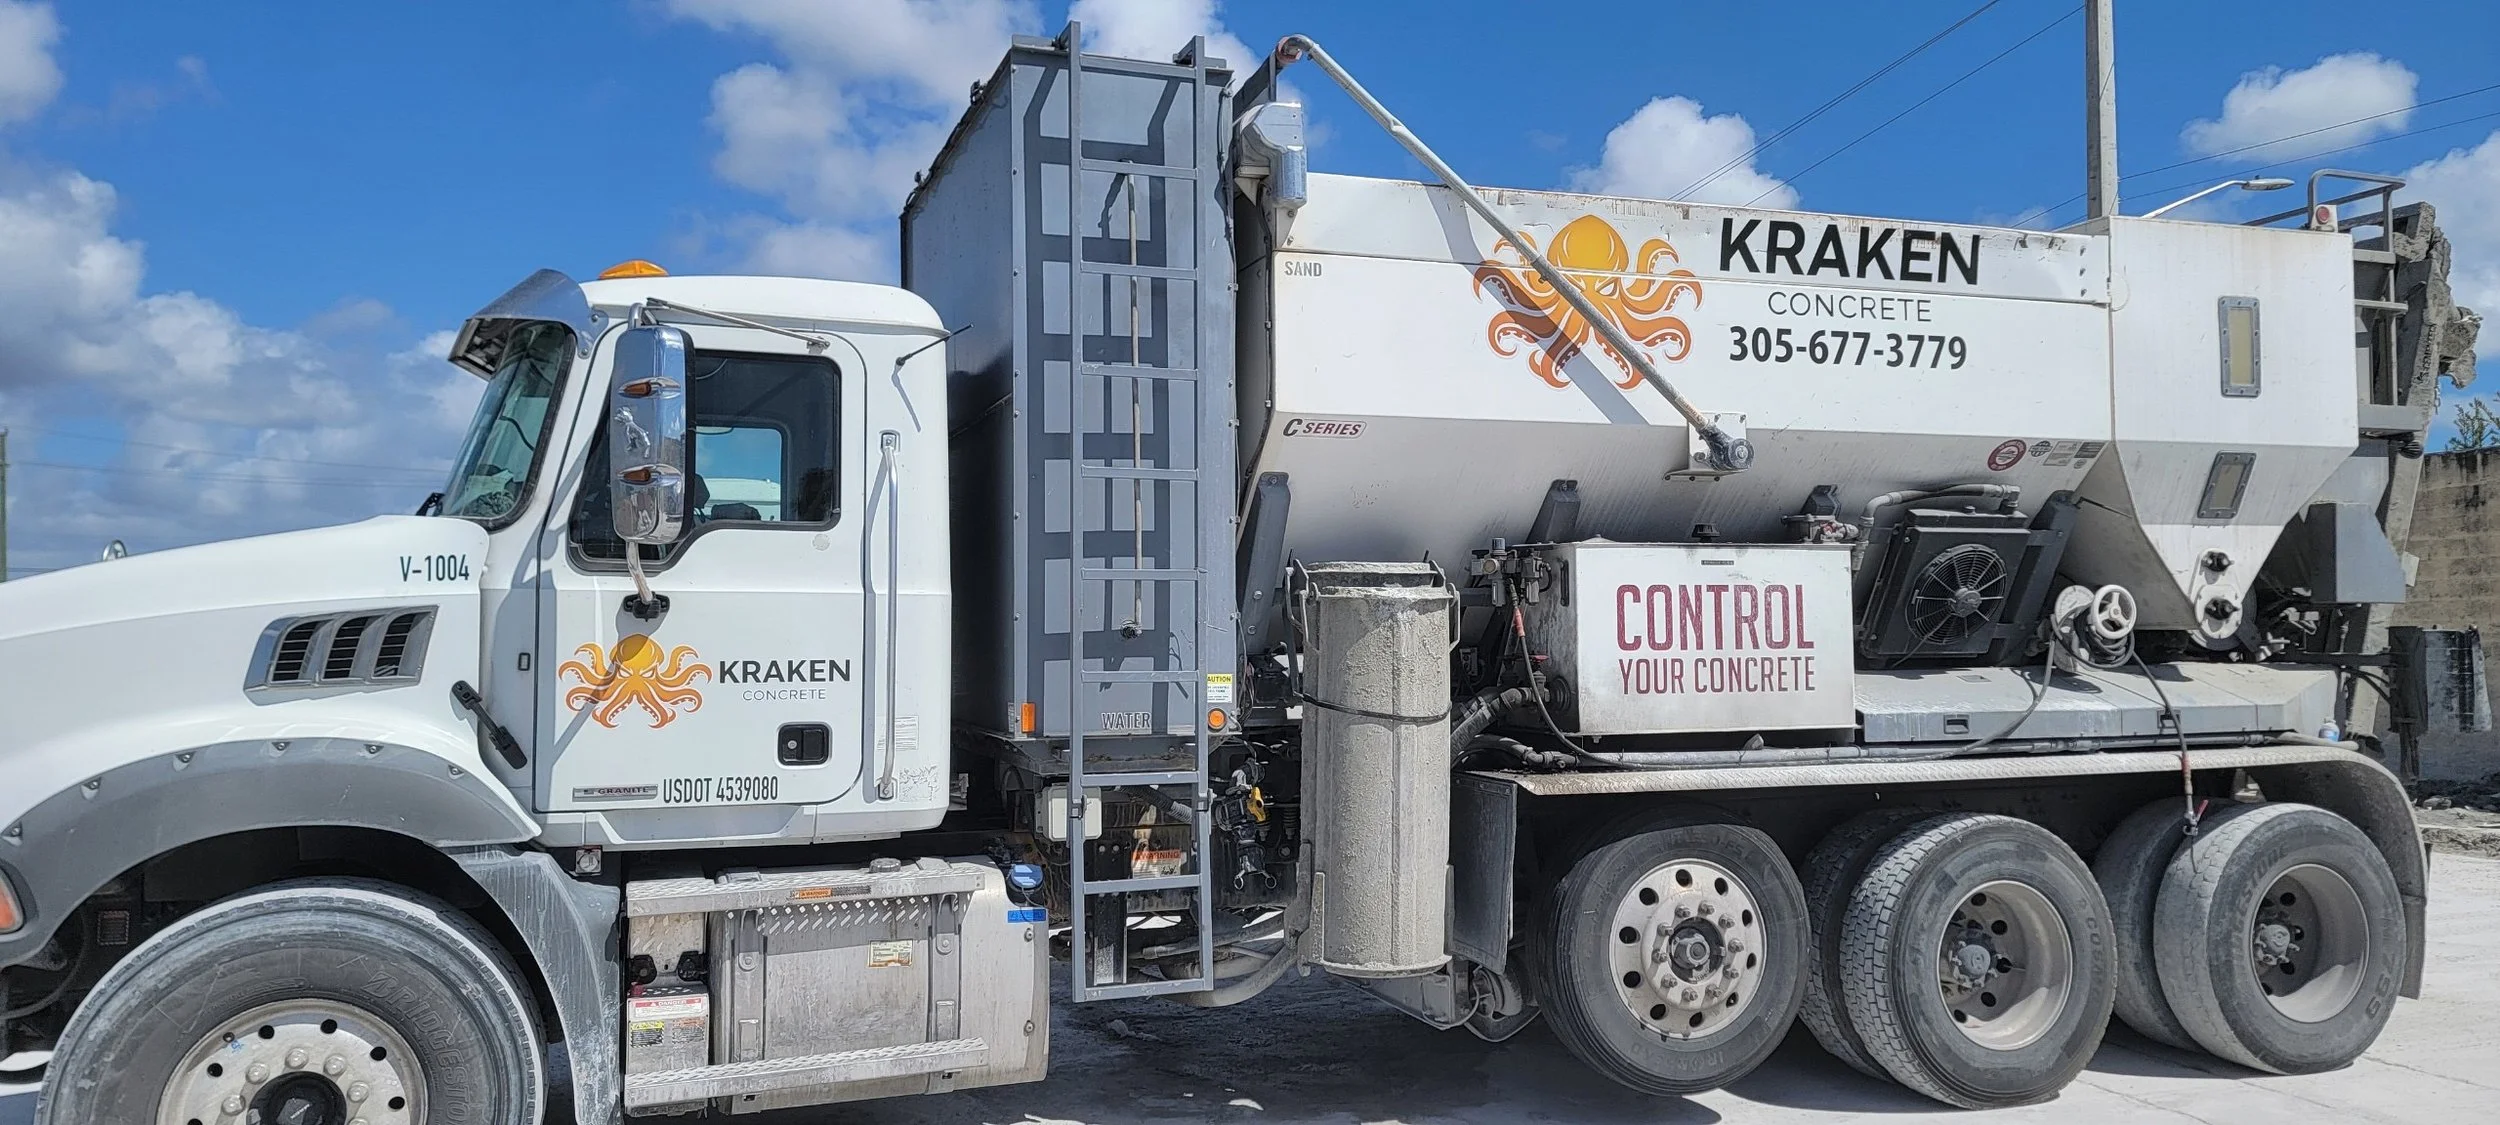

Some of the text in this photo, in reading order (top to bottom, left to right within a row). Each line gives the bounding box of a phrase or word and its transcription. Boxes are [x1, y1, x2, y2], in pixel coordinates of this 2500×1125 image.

[1719, 217, 1981, 285] KRAKEN
[1284, 261, 1322, 277] SAND
[1768, 291, 1932, 322] CONCRETE
[1729, 325, 1968, 370] 305-677-3779
[1283, 418, 1362, 437] C SERIES
[400, 554, 470, 582] V-1004
[1616, 584, 1815, 651] CONTROL
[719, 659, 851, 684] KRAKEN
[1619, 655, 1816, 695] YOUR CONCRETE
[742, 689, 827, 701] CONCRETE
[1102, 712, 1151, 730] WATER
[597, 786, 650, 795] GRANITE
[663, 775, 778, 803] USDOT 4539080
[361, 970, 471, 1125] BRIDGESTO
